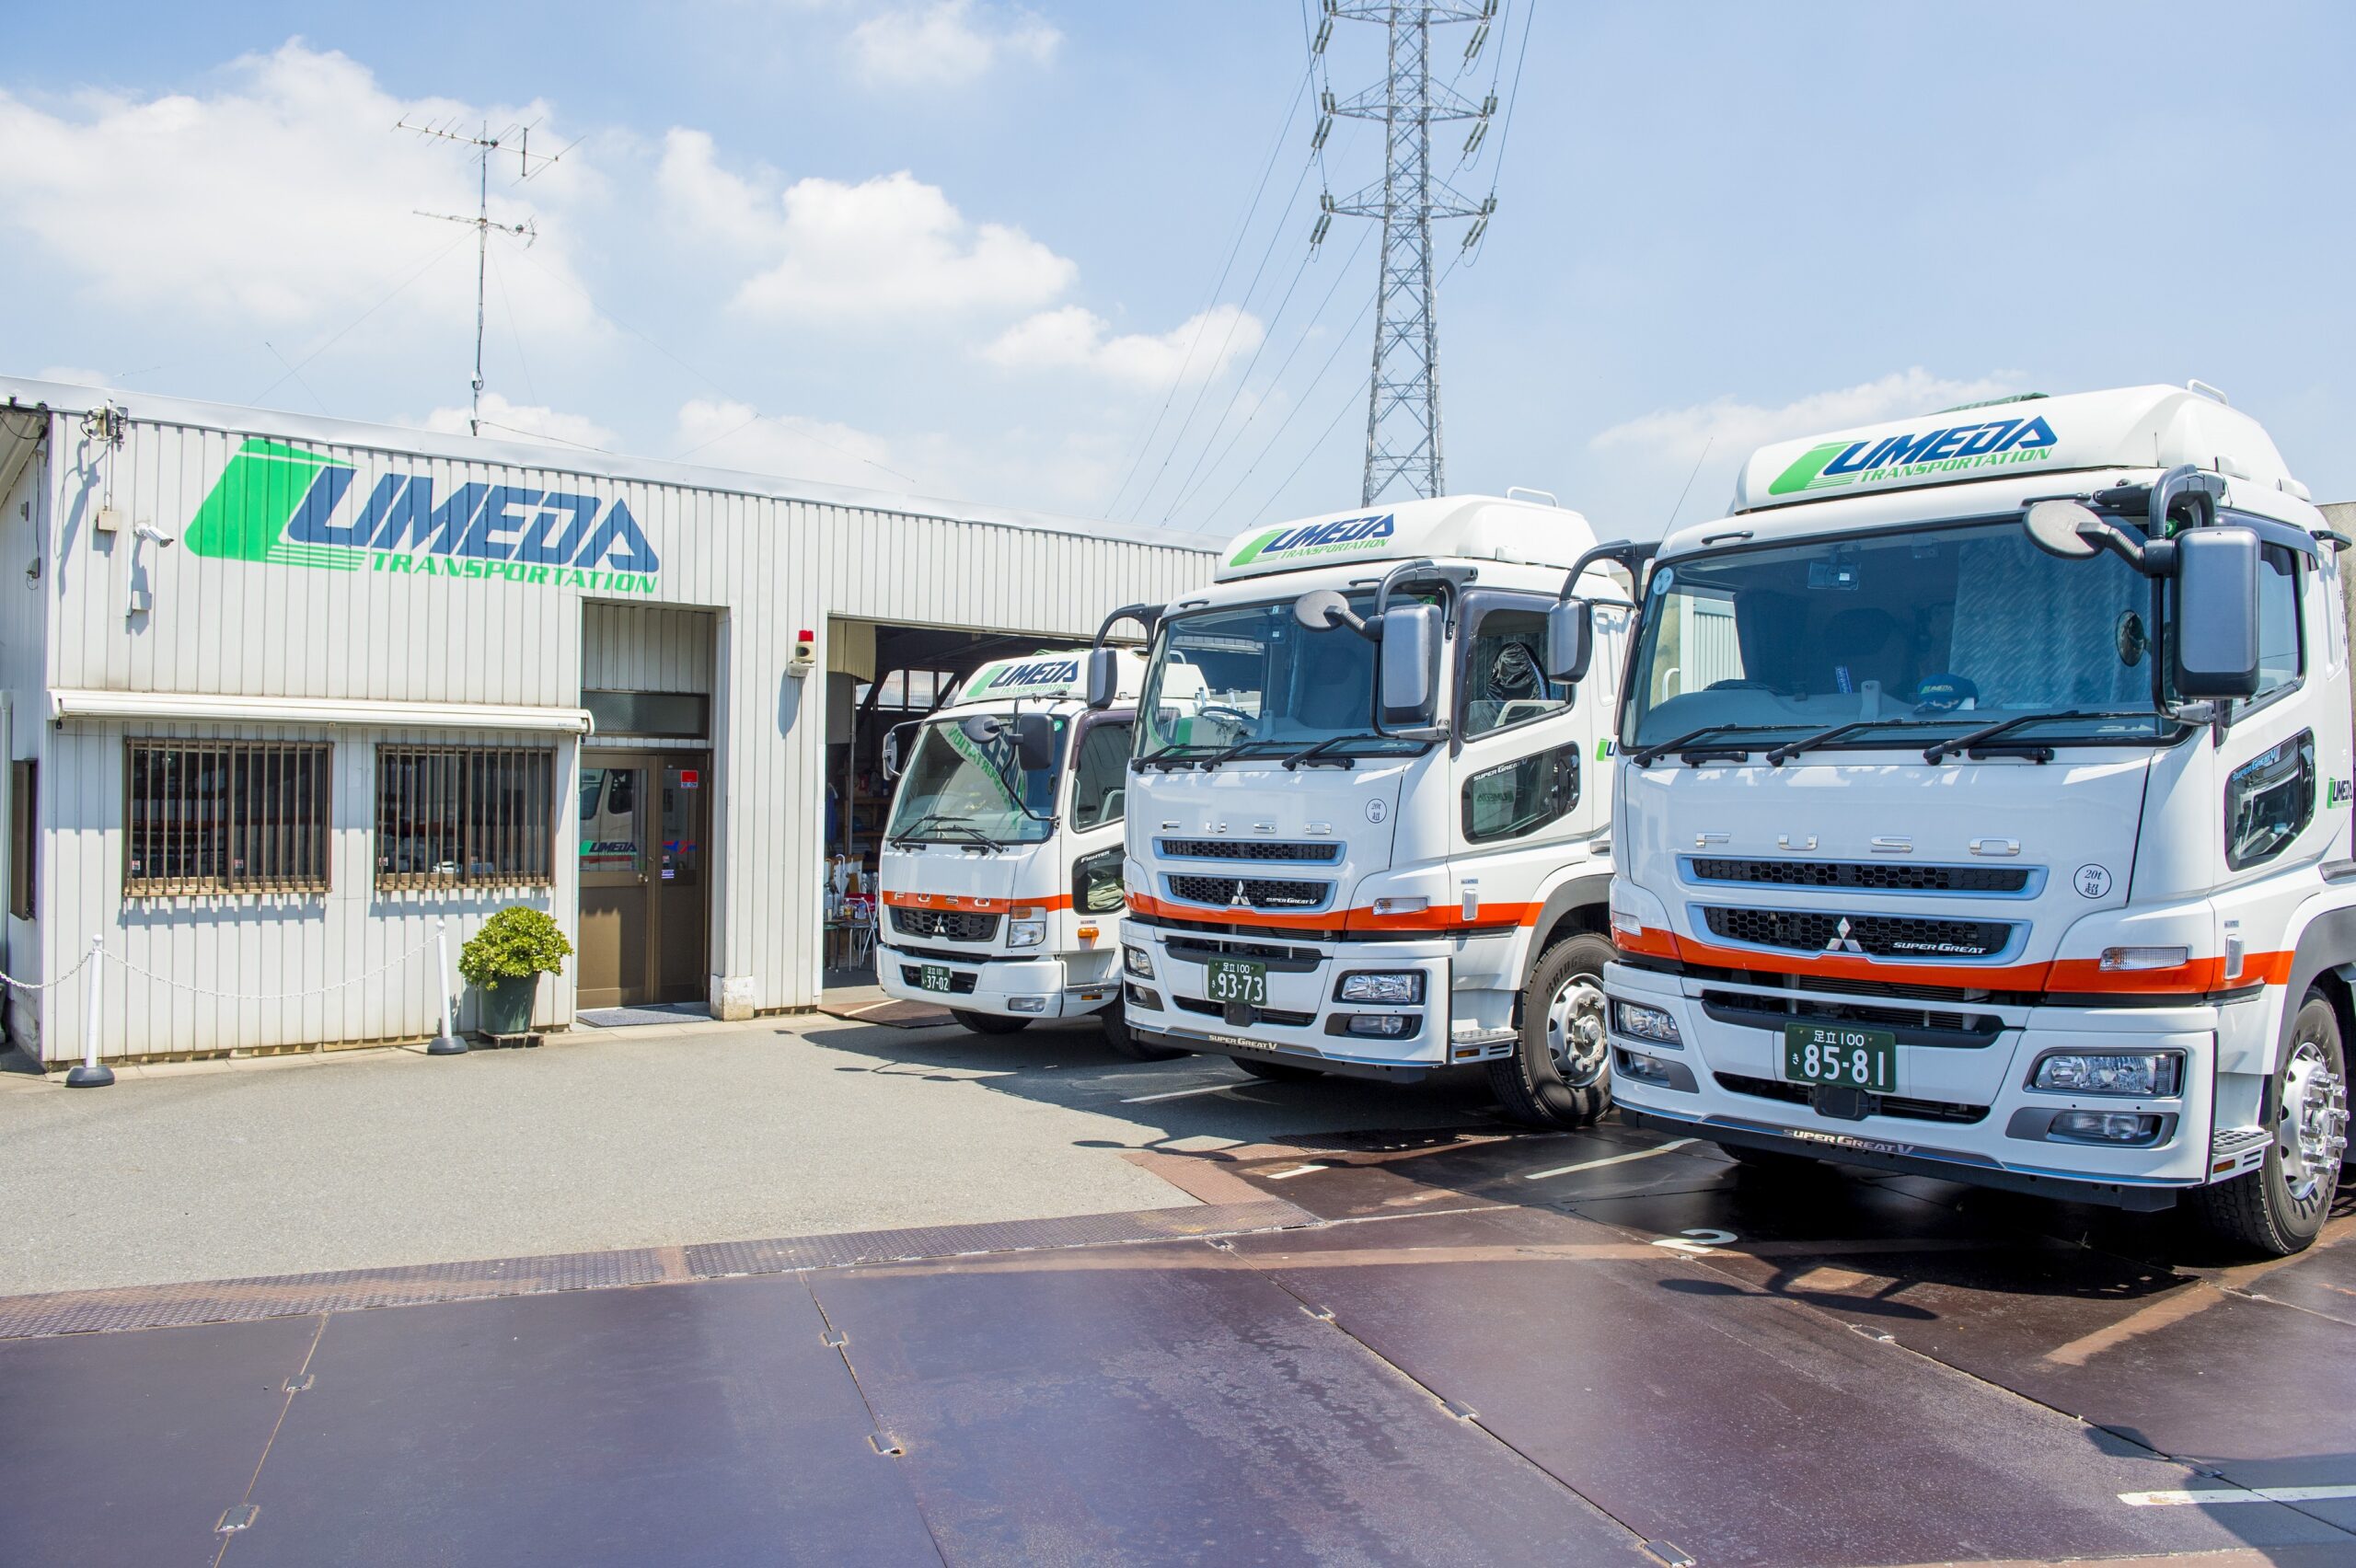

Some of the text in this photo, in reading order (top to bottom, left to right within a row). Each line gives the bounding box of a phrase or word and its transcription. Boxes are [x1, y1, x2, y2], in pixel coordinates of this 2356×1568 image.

[1822, 415, 2058, 476] UMEDA
[1860, 447, 2052, 483] TRANSPORTATION
[288, 466, 660, 572] UMEDA
[1261, 513, 1394, 553] UMEDA
[1280, 538, 1390, 559] TRANSPORTATION
[372, 552, 658, 594] TRANSPORTATION
[988, 660, 1080, 688] UMEDA
[1473, 769, 1497, 781] SUPER
[2232, 766, 2253, 782] SUPER
[2252, 756, 2272, 770] GREAT
[1162, 819, 1332, 836] FUSO
[589, 842, 637, 852] UMEDA
[1080, 850, 1110, 863] FIGHTER
[1696, 832, 2020, 857] FUSO
[2085, 869, 2102, 881] 20t
[894, 892, 990, 907] FUSO
[2085, 882, 2099, 895] 超
[1893, 941, 1986, 954] SUPER GREAT
[927, 975, 949, 991] 37-02
[1218, 973, 1264, 1002] 93-73
[1209, 1034, 1278, 1050] SUPER GREAT V
[1792, 1043, 1884, 1086] き 85-81
[1782, 1129, 1915, 1155] SUPER GREAT V
[1651, 1228, 1738, 1254] 2
